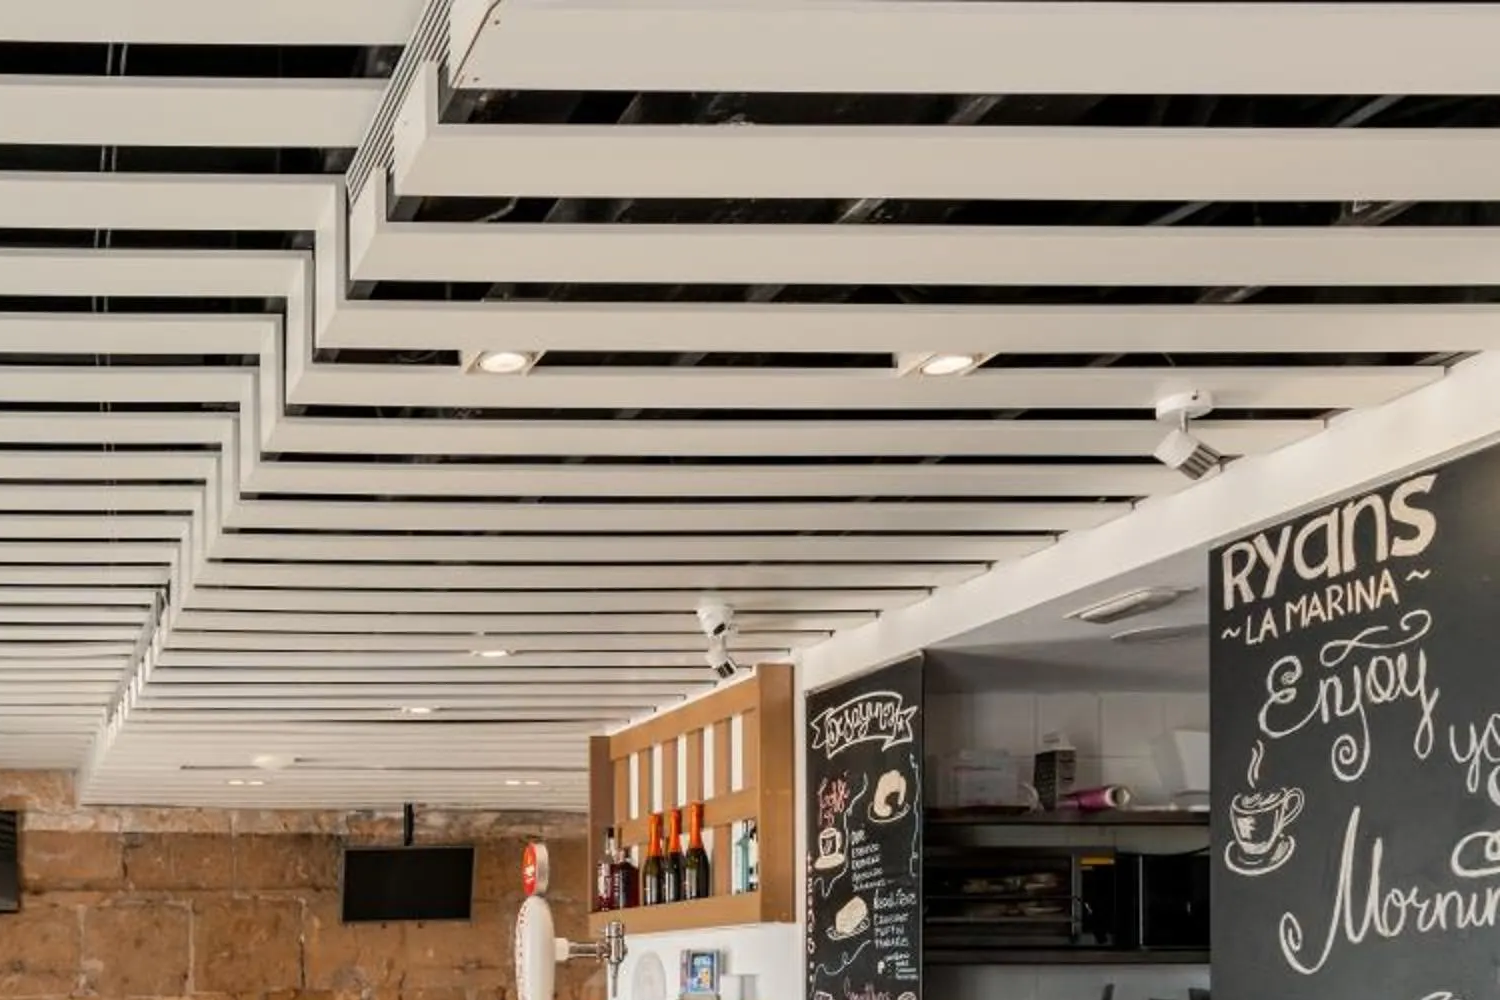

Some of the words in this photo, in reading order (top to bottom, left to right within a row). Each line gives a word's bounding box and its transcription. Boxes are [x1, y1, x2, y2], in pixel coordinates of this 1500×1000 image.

[1221, 473, 1439, 612] Ryans
[1245, 607, 1279, 646] LA
[1285, 567, 1400, 633] MARINA
[1258, 648, 1440, 782] Enjoy
